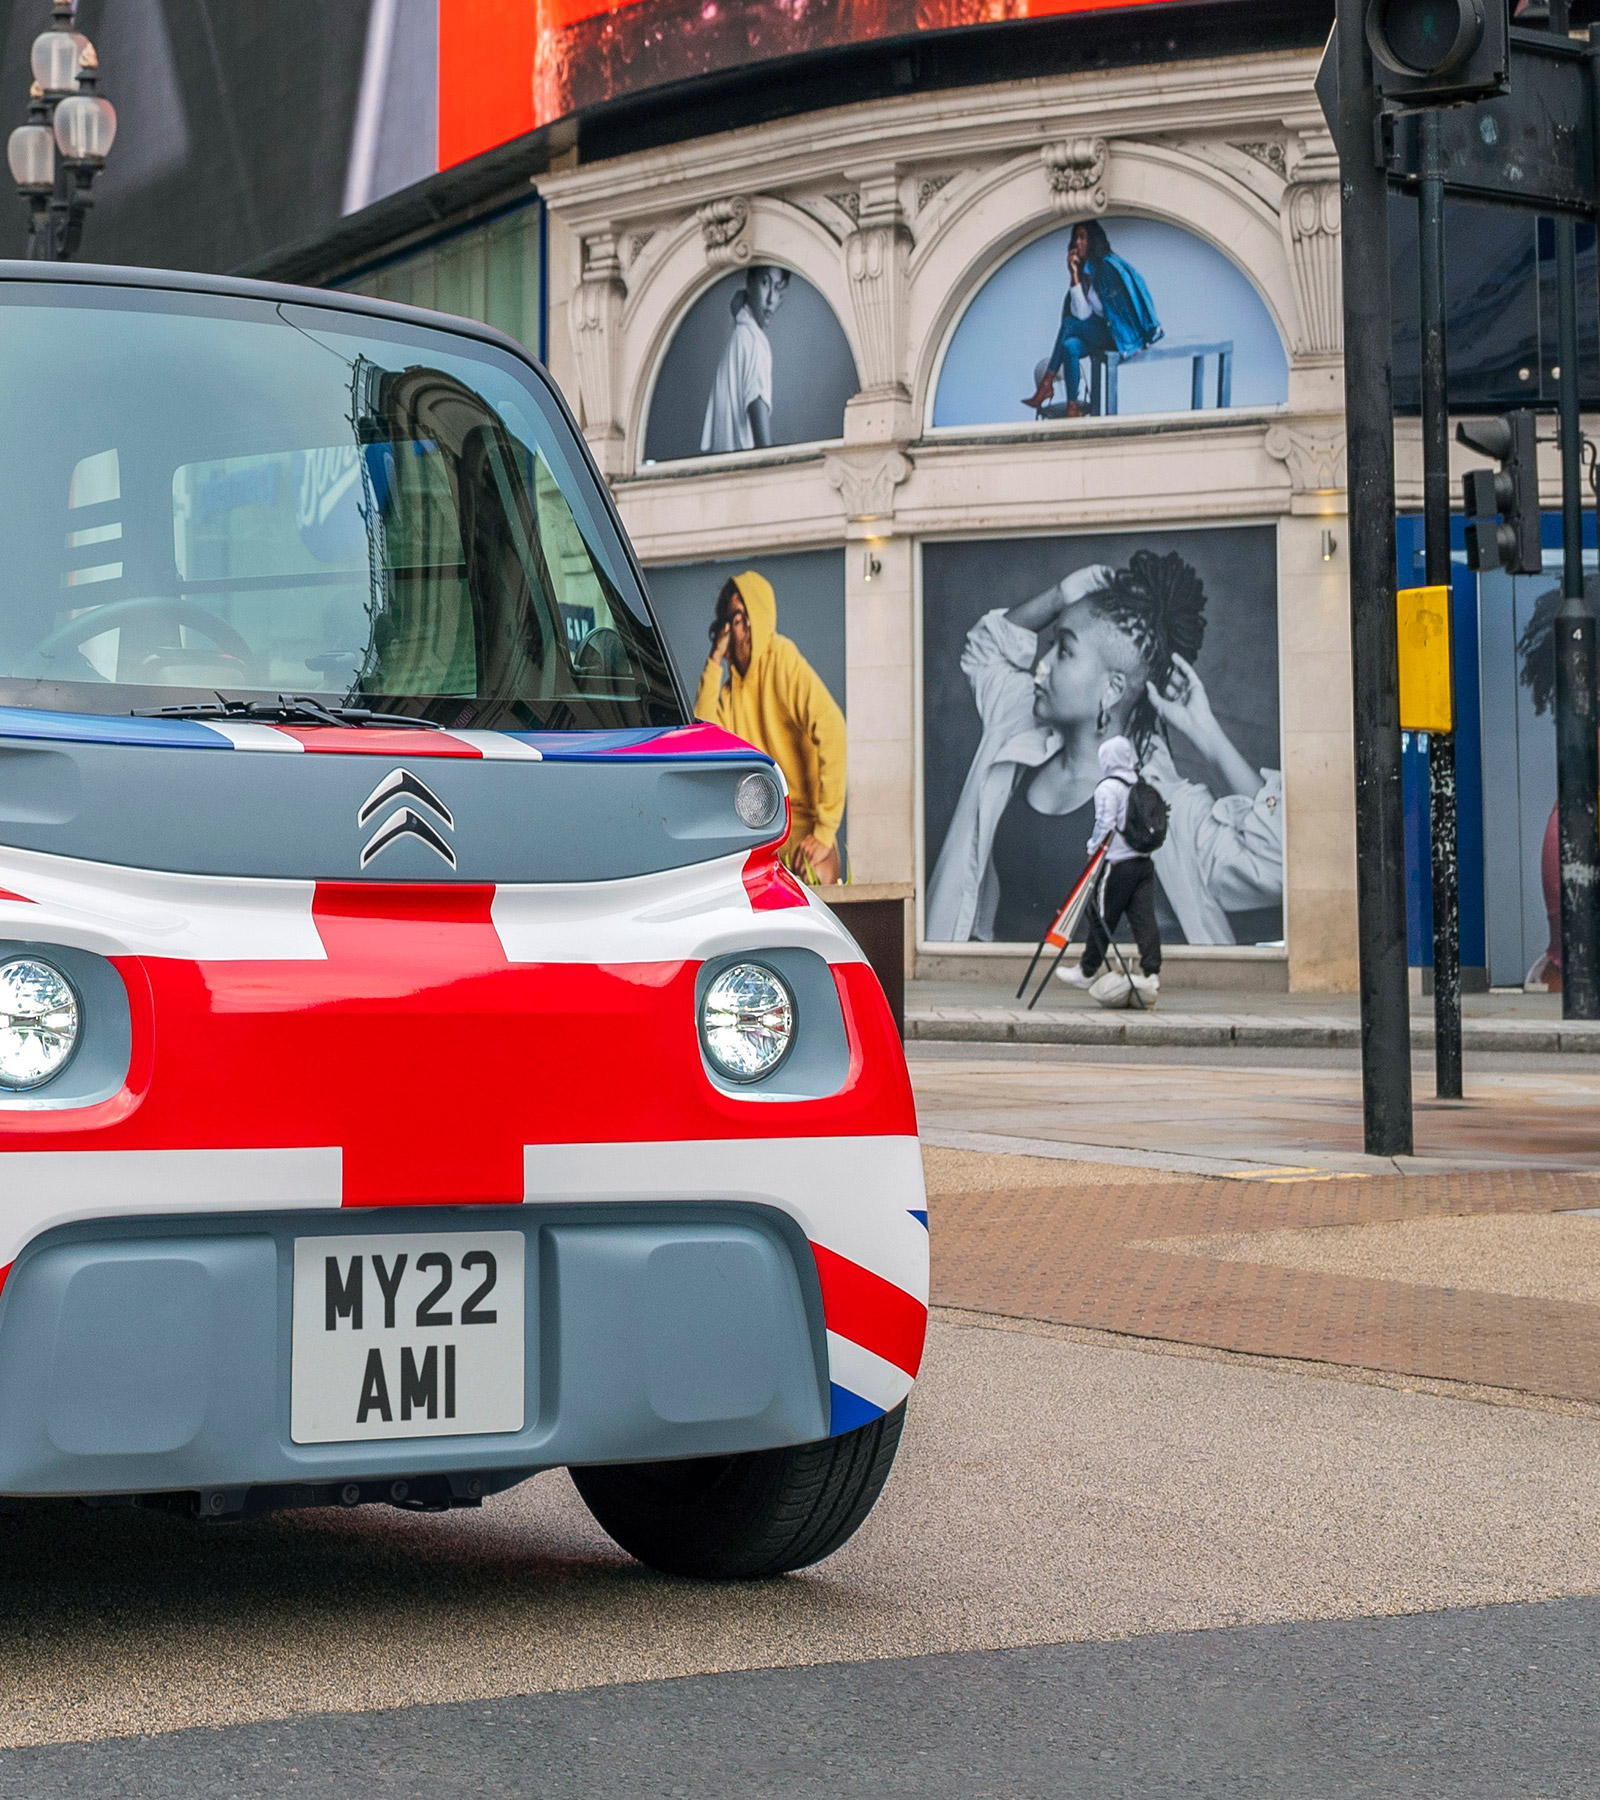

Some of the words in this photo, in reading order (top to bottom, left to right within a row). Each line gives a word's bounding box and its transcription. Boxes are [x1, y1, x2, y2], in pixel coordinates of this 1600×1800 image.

[1572, 628, 1582, 641] 4
[325, 1251, 497, 1331] MY22
[356, 1344, 456, 1424] AMI
